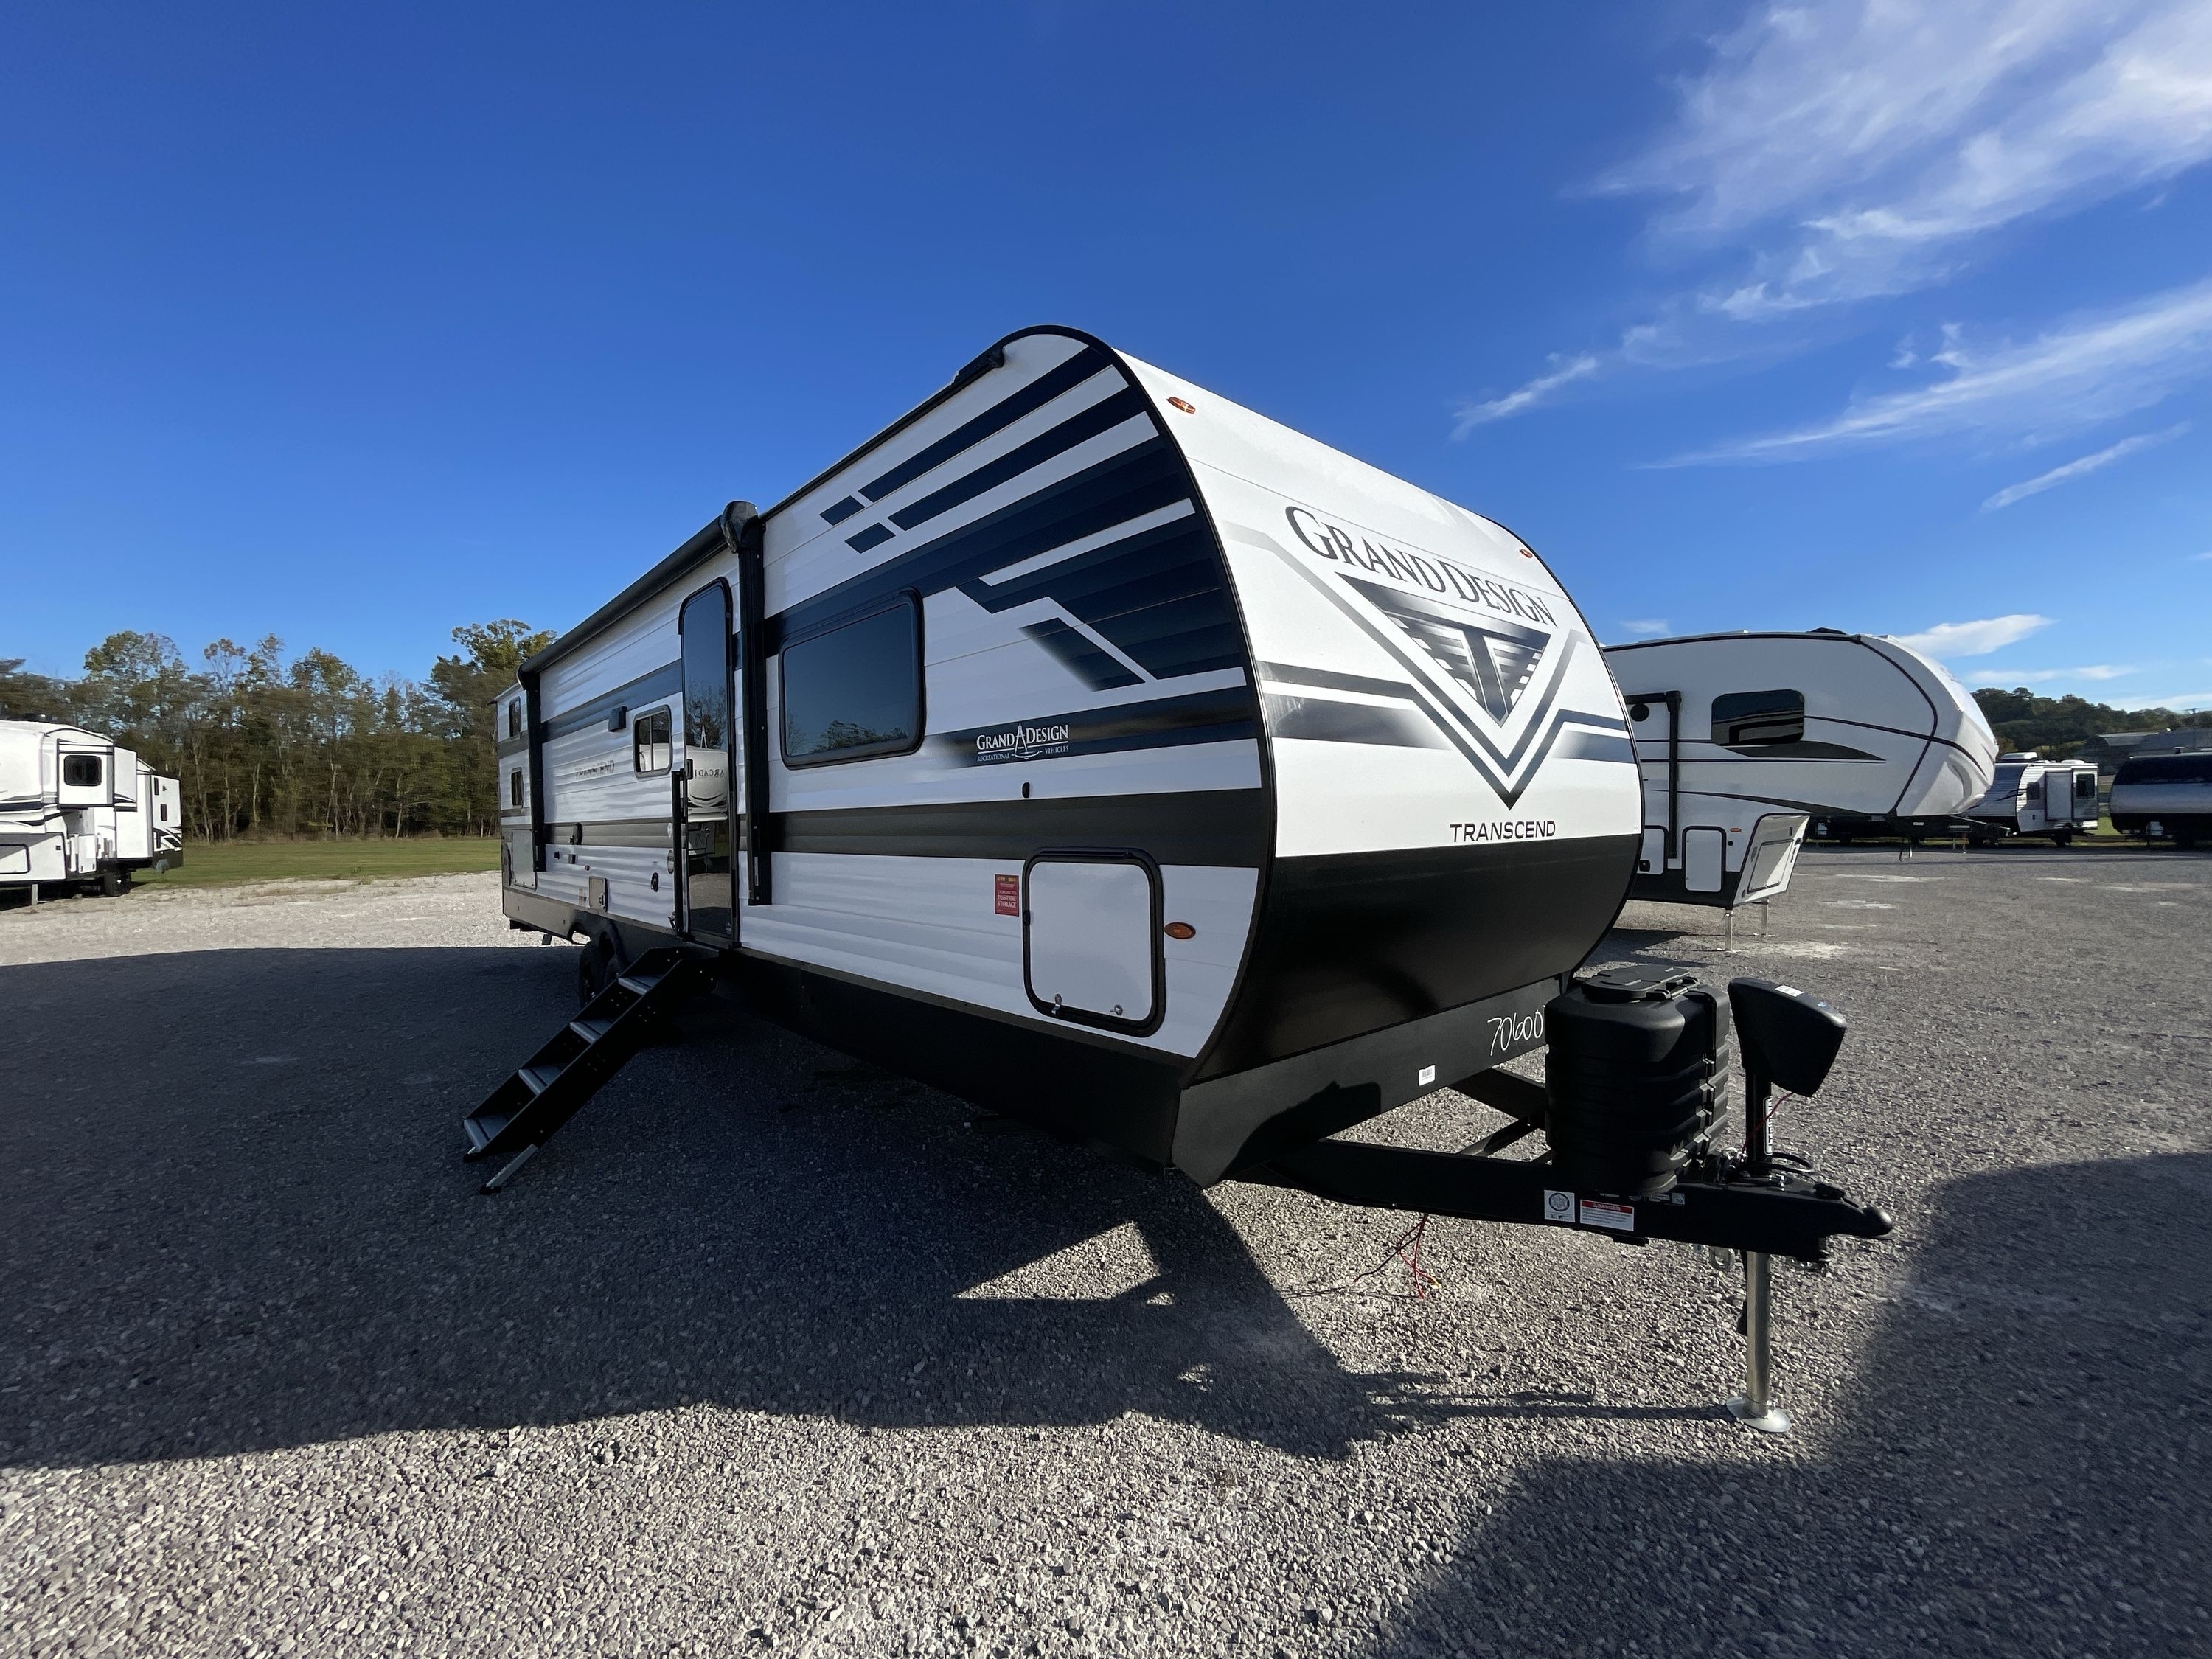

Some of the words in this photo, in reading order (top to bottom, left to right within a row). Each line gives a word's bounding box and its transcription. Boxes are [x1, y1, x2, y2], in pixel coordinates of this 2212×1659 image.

[1285, 506, 1447, 593] GRAND
[1433, 557, 1559, 628] DESIGN
[976, 733, 1015, 750] GRAND
[1026, 724, 1069, 745] DESIGN
[977, 753, 1010, 762] RECREATIONAL
[1045, 745, 1069, 754] VEHICLES
[1450, 821, 1557, 842] TRANSCEND
[1487, 1005, 1545, 1056] 70600
